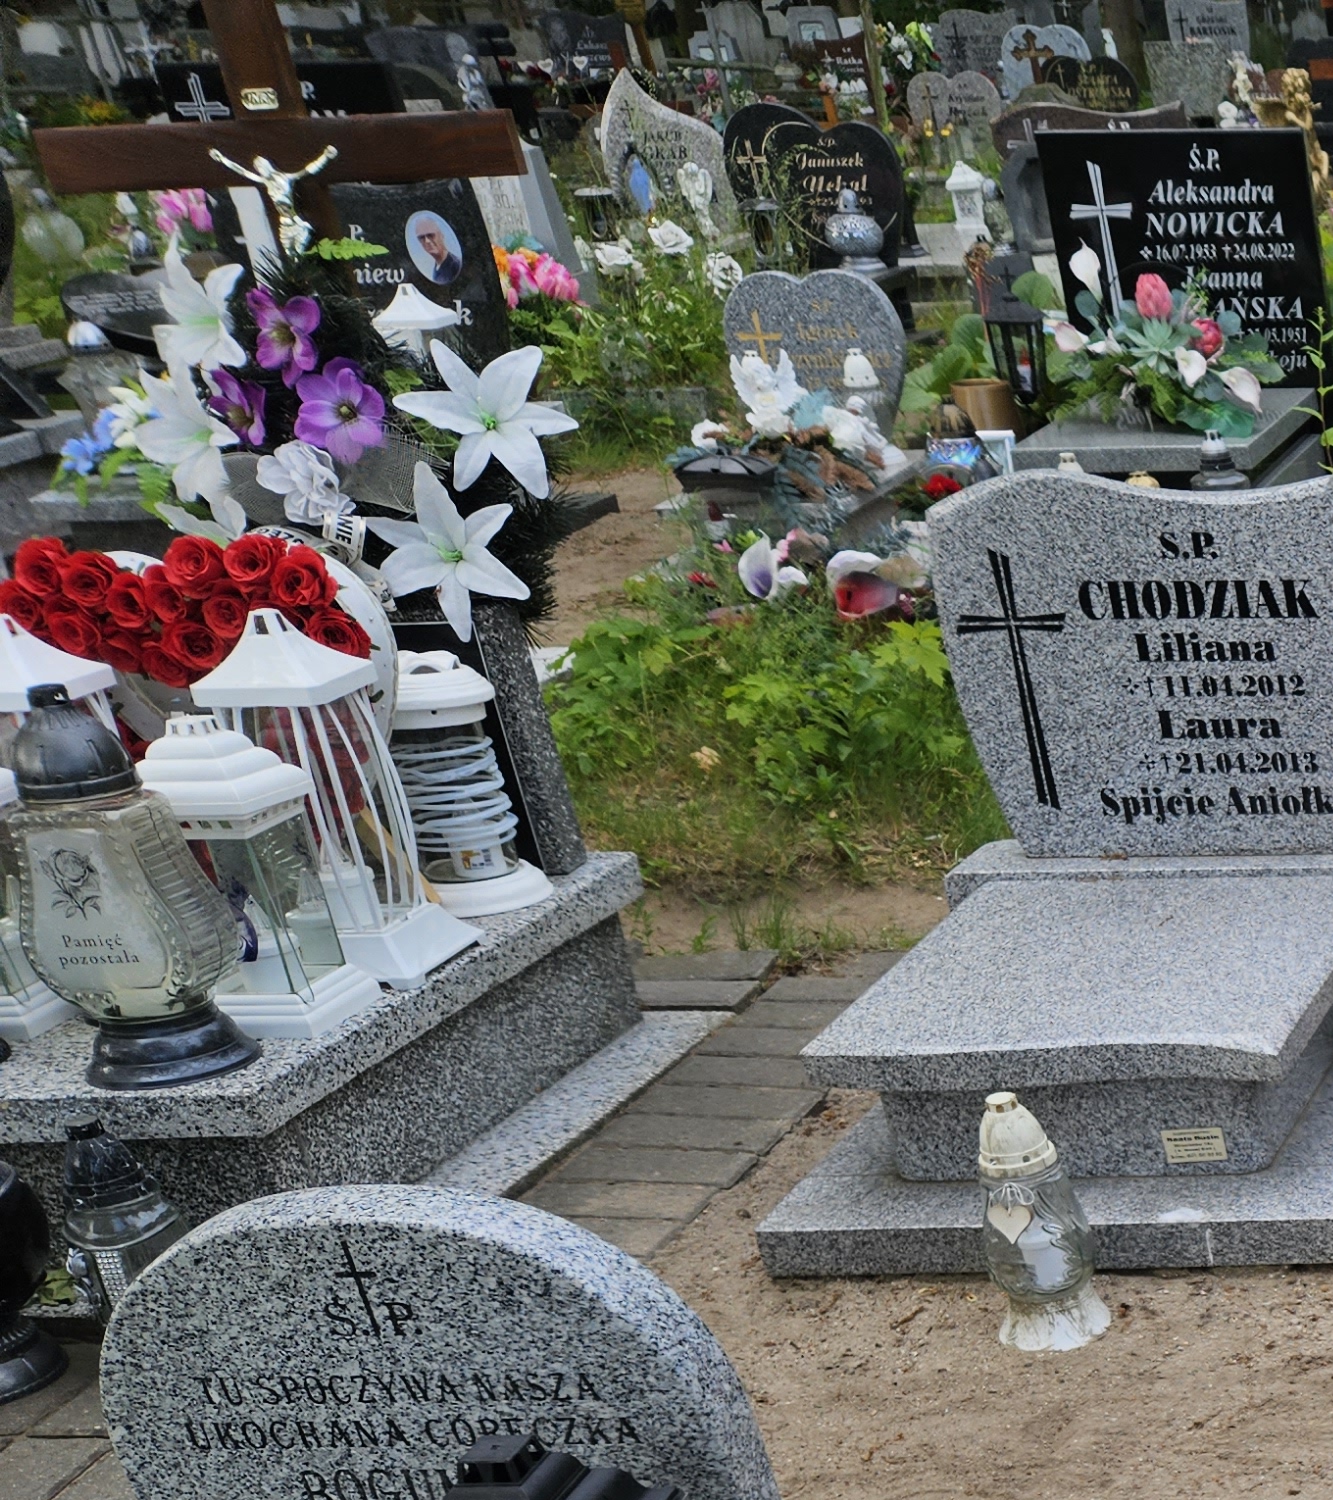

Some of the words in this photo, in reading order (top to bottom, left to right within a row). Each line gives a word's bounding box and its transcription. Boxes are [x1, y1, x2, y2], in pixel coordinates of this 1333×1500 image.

[1188, 143, 1221, 171] Ś.P.
[1148, 178, 1275, 205] Aleksandra
[1145, 210, 1285, 238] NOWICKA
[1214, 290, 1304, 321] AŃSKA
[1077, 579, 1320, 621] CHODZIAK
[1134, 631, 1277, 664] Liliana
[1165, 674, 1306, 699] 11.04.2012
[1157, 709, 1282, 741] Laura
[1176, 751, 1320, 776] 21.04.2013
[61, 933, 123, 950] Pamięć
[255, 1371, 459, 1406] SPOCZYWA
[472, 1370, 600, 1402] NASZA
[185, 1417, 410, 1452] UKOCHANA
